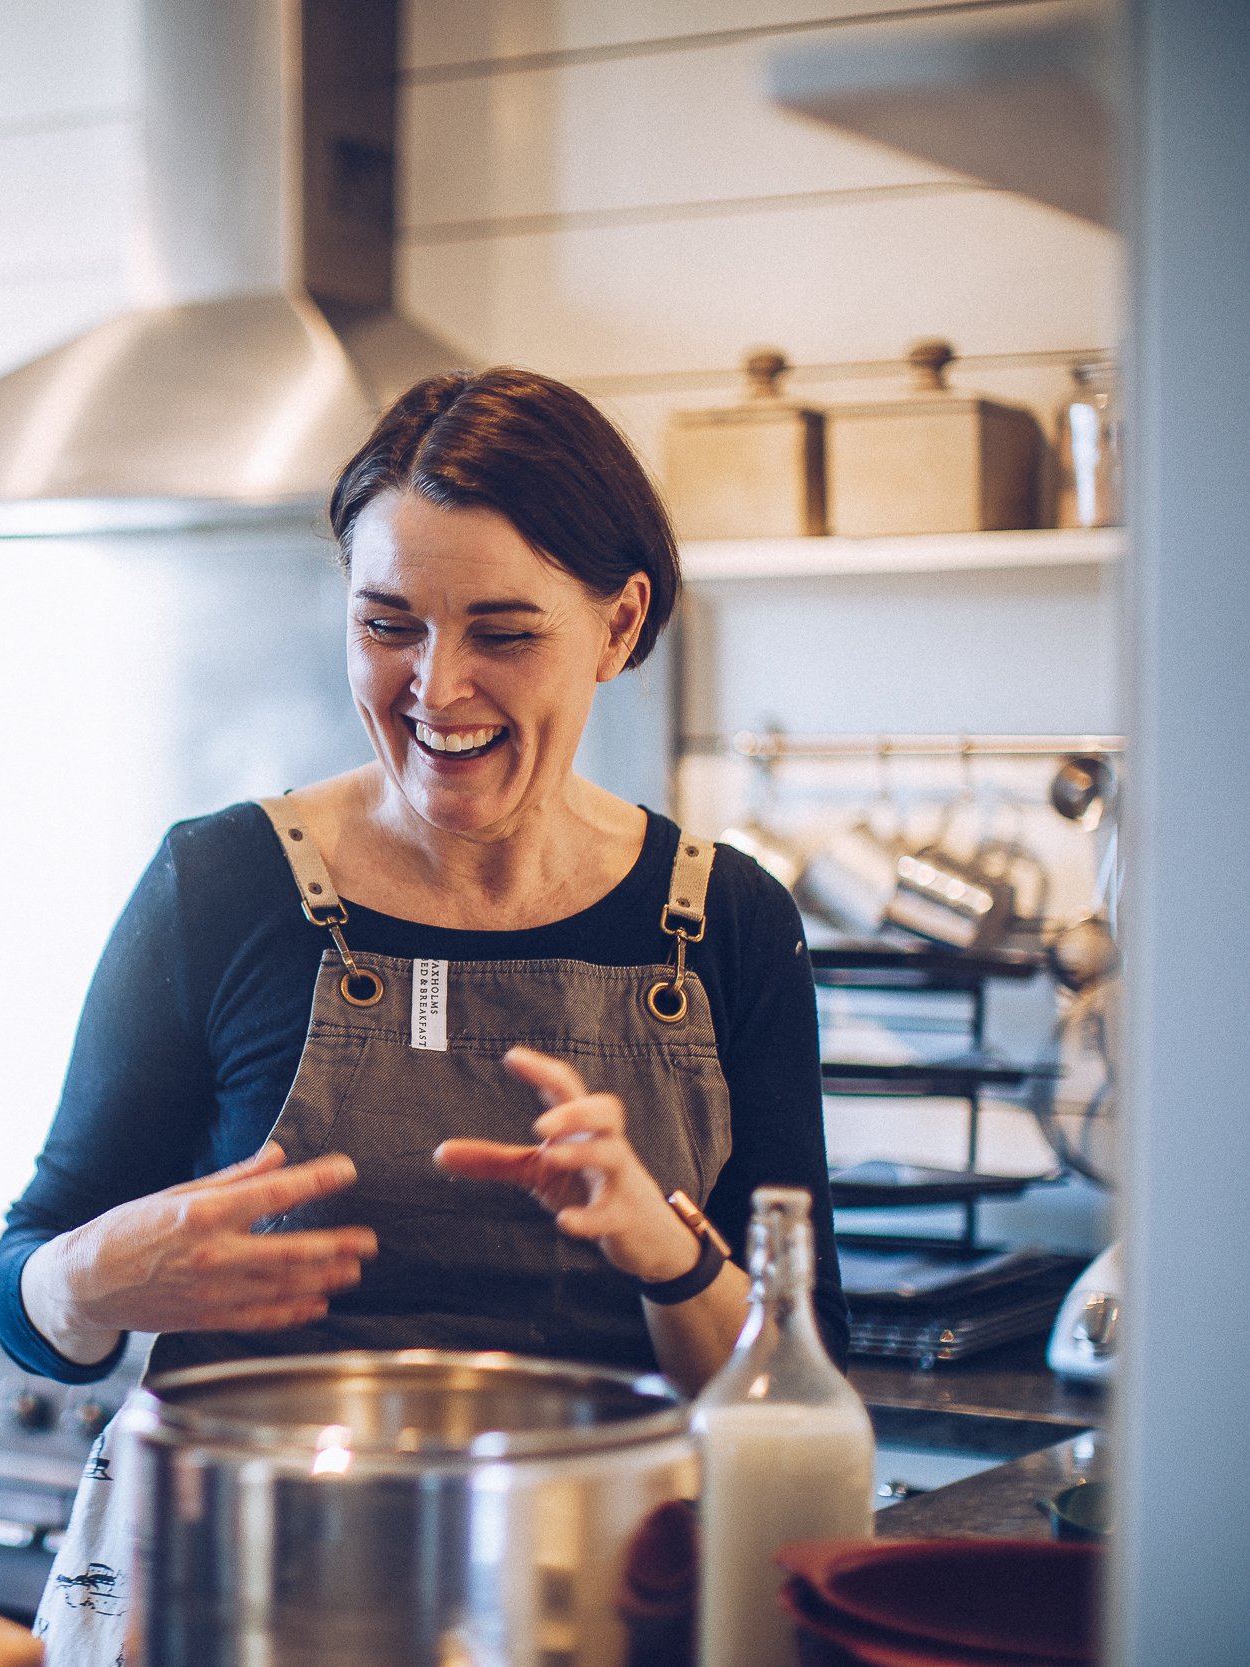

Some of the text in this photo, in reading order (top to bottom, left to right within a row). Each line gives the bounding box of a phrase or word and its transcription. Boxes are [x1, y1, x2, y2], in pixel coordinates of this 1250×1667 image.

[418, 959, 429, 1047] ED & BREAKFAST
